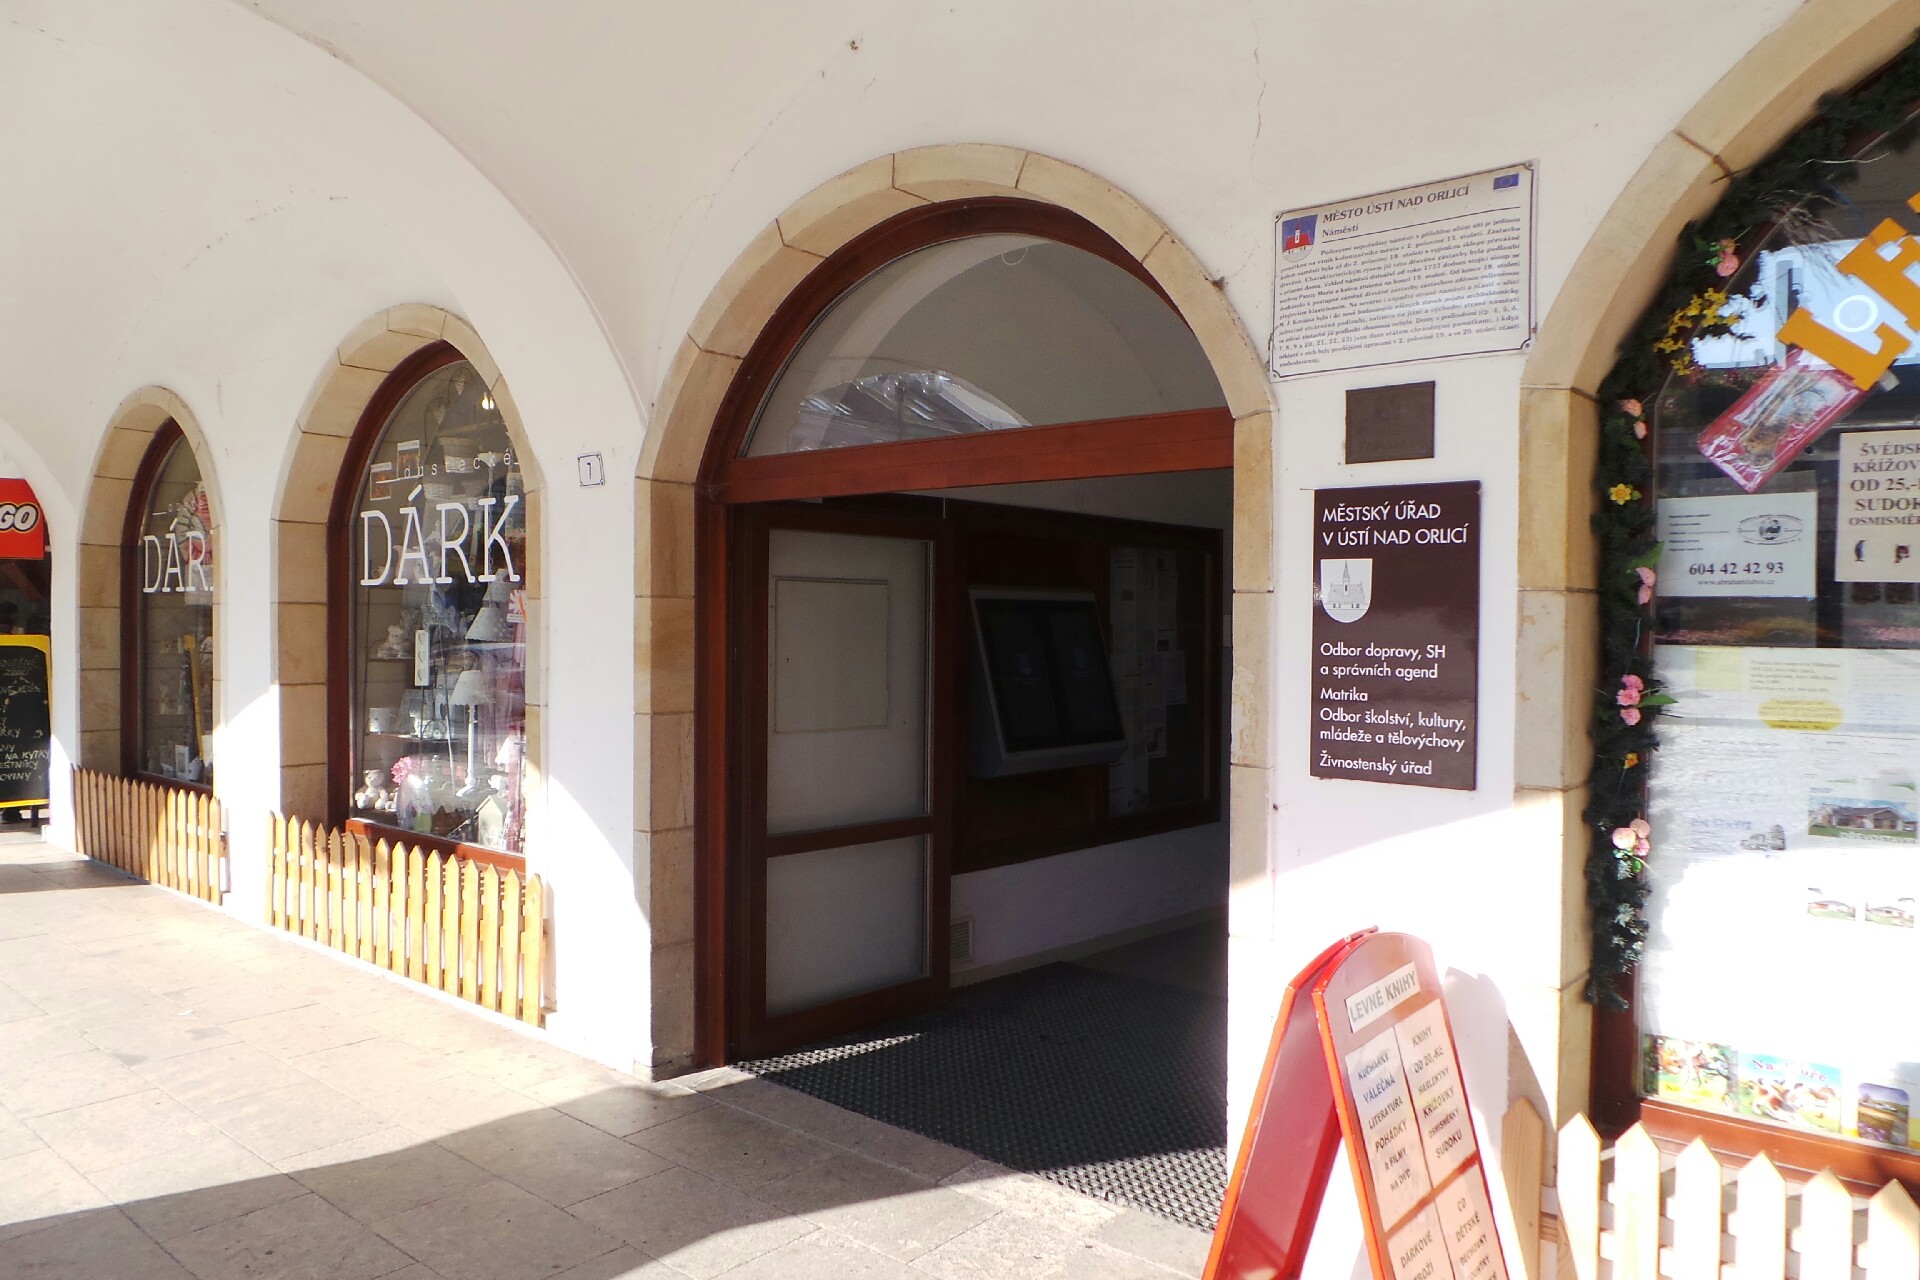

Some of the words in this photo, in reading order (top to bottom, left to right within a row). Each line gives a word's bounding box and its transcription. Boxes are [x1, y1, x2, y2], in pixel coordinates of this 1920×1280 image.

[1322, 206, 1362, 223] MĚSTO
[1366, 199, 1393, 214] ÚSTÍ
[1397, 196, 1423, 208] NAD
[1427, 185, 1469, 203] ORLICÍ
[1322, 223, 1358, 237] Náměstí
[1850, 479, 1879, 491] OD
[1886, 478, 1920, 492] 25,-
[1322, 501, 1391, 522] MĚSTSKÝ
[1395, 500, 1441, 520] ÚŘAD
[1322, 532, 1334, 546] V
[1338, 526, 1370, 546] ÚSTÍ
[1373, 530, 1411, 545] NAD
[1415, 523, 1469, 544] ORLICÍ
[143, 517, 213, 592] DÁR
[1689, 563, 1715, 575] 604
[1720, 563, 1737, 574] 42
[1743, 563, 1761, 574] 42
[1766, 562, 1784, 574] 93
[1320, 642, 1362, 656] Odbor
[1365, 642, 1421, 661] dopravy,
[1426, 645, 1446, 658] SH
[1320, 666, 1328, 675] a
[1333, 662, 1391, 679] správních
[1395, 663, 1438, 681] agend
[1320, 687, 1368, 701] Matrika
[1320, 707, 1361, 722] Odbor
[1365, 709, 1414, 728] školství,
[1418, 712, 1466, 732] kultury,
[1320, 726, 1372, 742] mládeže
[1376, 735, 1383, 743] a
[1388, 730, 1465, 752] tělovýchovy
[1320, 750, 1397, 775] Živnostenský
[1401, 760, 1432, 775] úřad
[1350, 986, 1384, 1022] LEVNÉ
[1385, 970, 1415, 1001] KNIHY
[1412, 1026, 1432, 1047] KNIHY
[1368, 1096, 1403, 1130] LITERATURA
[1436, 1129, 1462, 1158] SUDOKU
[1457, 1198, 1467, 1213] CD
